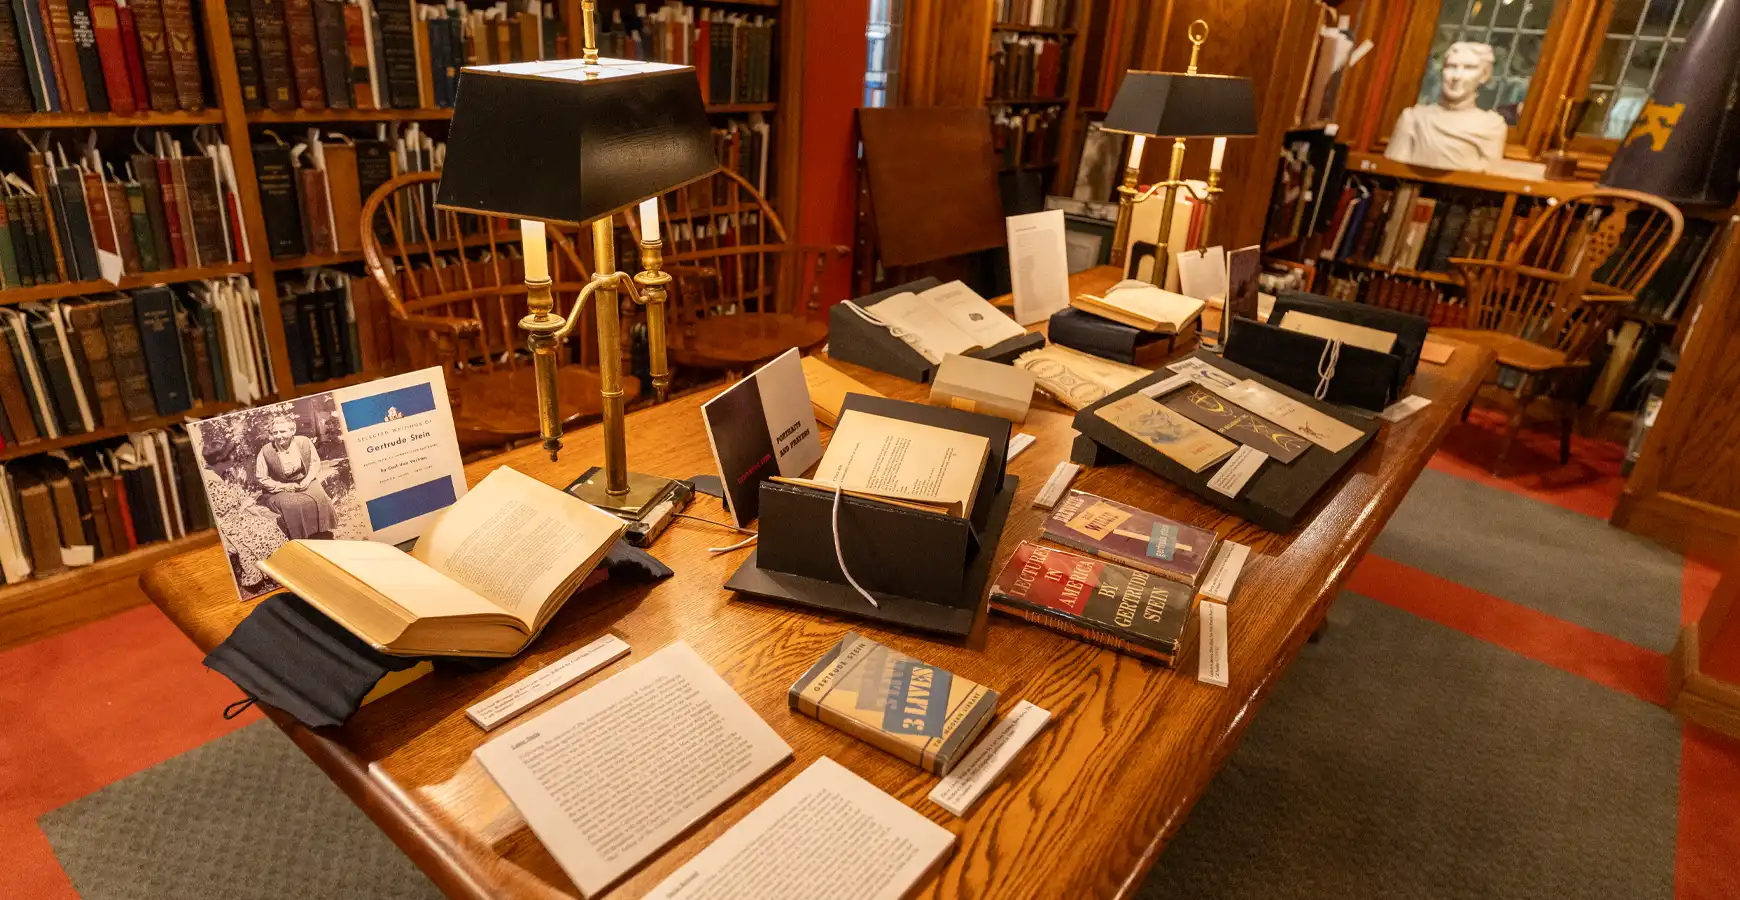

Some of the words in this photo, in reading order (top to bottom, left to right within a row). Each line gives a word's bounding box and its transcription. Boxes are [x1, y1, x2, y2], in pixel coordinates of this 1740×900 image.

[357, 430, 389, 443] SELECTED
[366, 436, 407, 454] Gertrude
[410, 431, 431, 442] Stein
[776, 420, 802, 444] PORTRAITS
[779, 444, 790, 458] AND
[790, 427, 810, 449] PRAYERS
[1010, 546, 1051, 597] LECTURES
[1044, 567, 1064, 582] IN
[1058, 560, 1095, 608] AMERICA
[1098, 581, 1119, 599] BY
[1114, 570, 1150, 628] GERTRUDE
[1143, 586, 1169, 623] STEIN
[1024, 609, 1076, 635] LECTURES
[813, 660, 848, 692] GERTRUDE
[847, 643, 866, 660] STEIN
[903, 666, 934, 717] LIVES
[902, 717, 925, 731] 3
[944, 713, 964, 734] MODERN
[963, 692, 981, 712] LIBRARY
